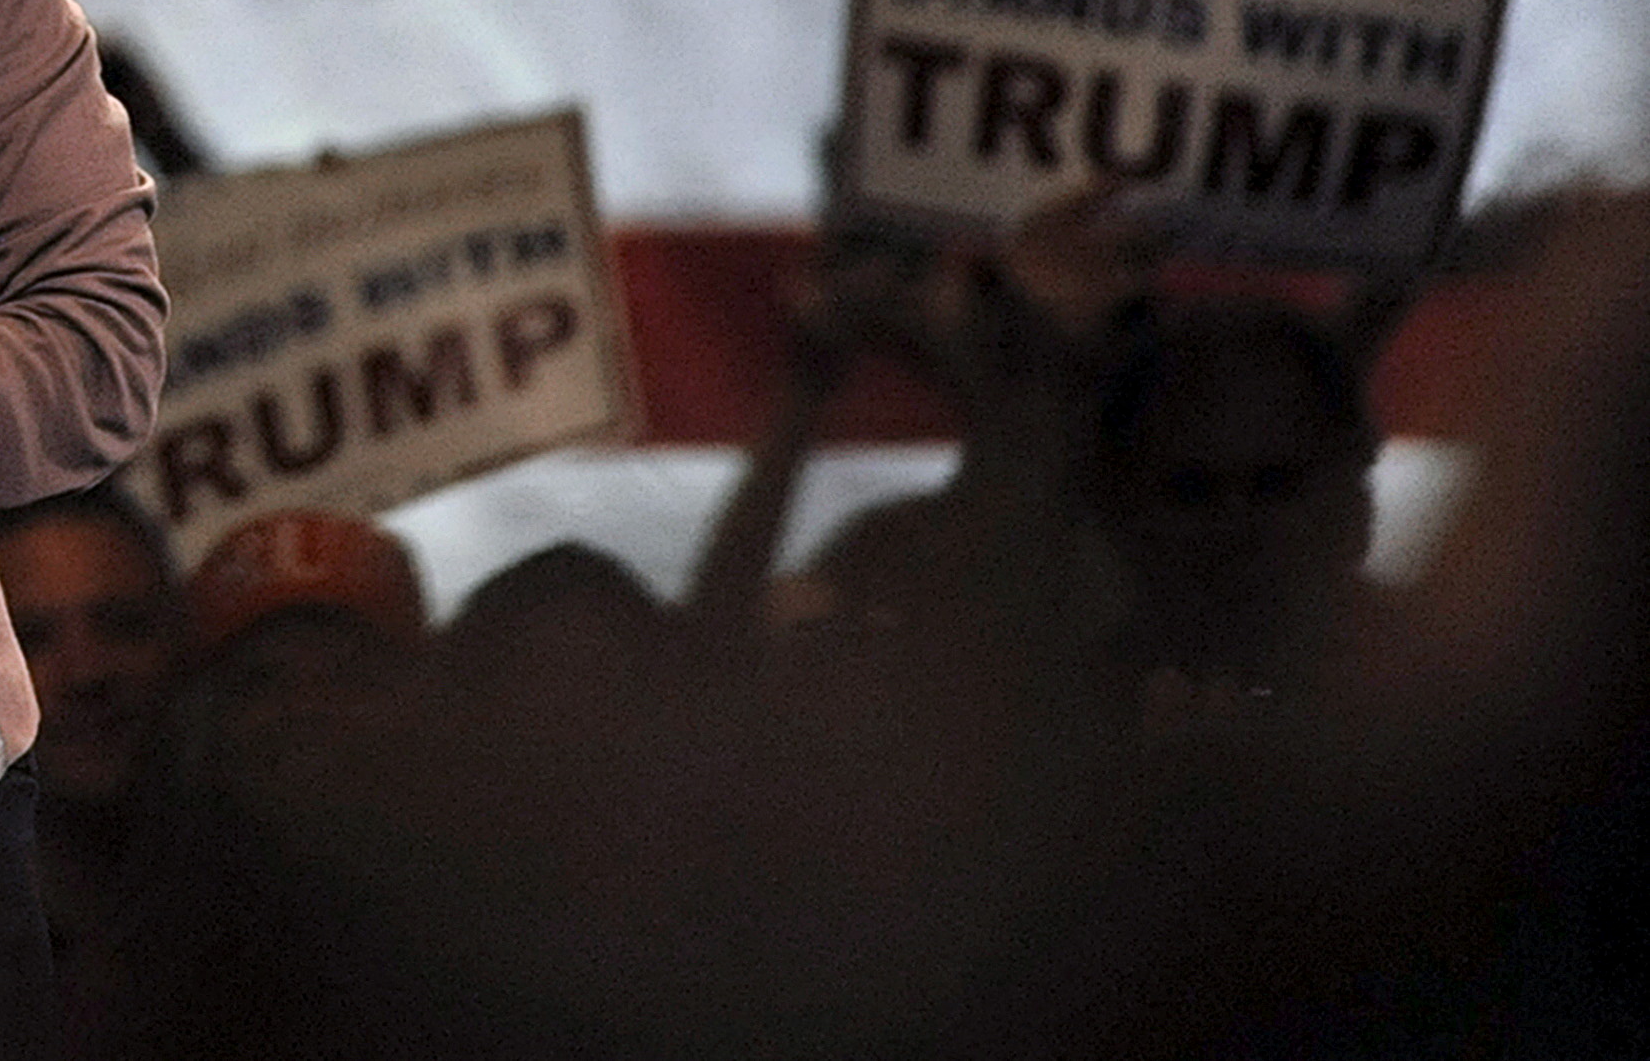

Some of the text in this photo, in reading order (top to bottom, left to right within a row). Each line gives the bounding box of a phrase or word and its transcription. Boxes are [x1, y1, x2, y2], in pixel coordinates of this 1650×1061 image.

[1242, 1, 1464, 87] WITH
[884, 38, 1439, 208] TRUMP
[360, 225, 566, 305] WITH
